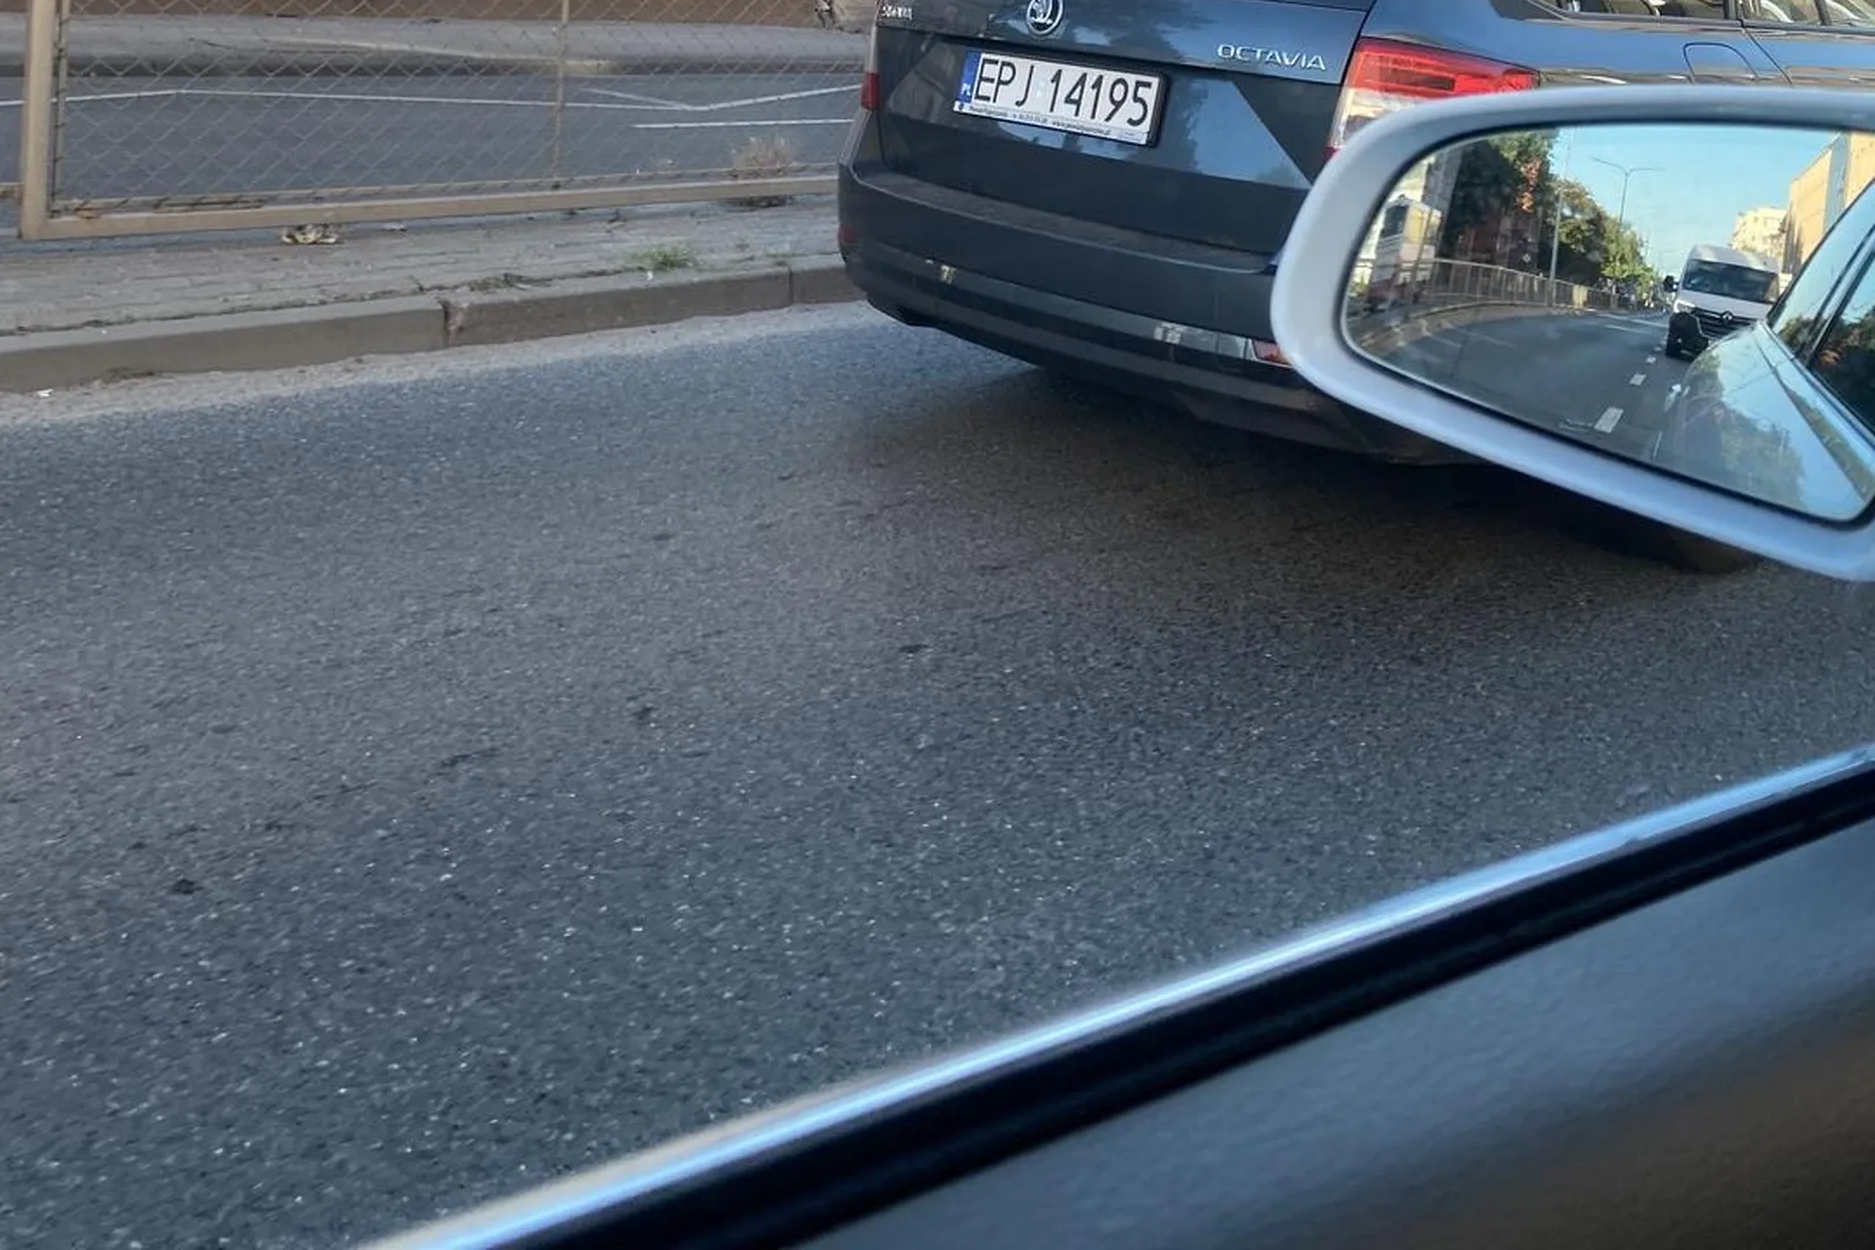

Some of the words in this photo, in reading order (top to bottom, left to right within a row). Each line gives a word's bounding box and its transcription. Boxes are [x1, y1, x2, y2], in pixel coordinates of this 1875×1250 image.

[1217, 44, 1326, 71] OCTAVIA
[974, 58, 1035, 108] EPJ
[1049, 68, 1152, 127] 14195
